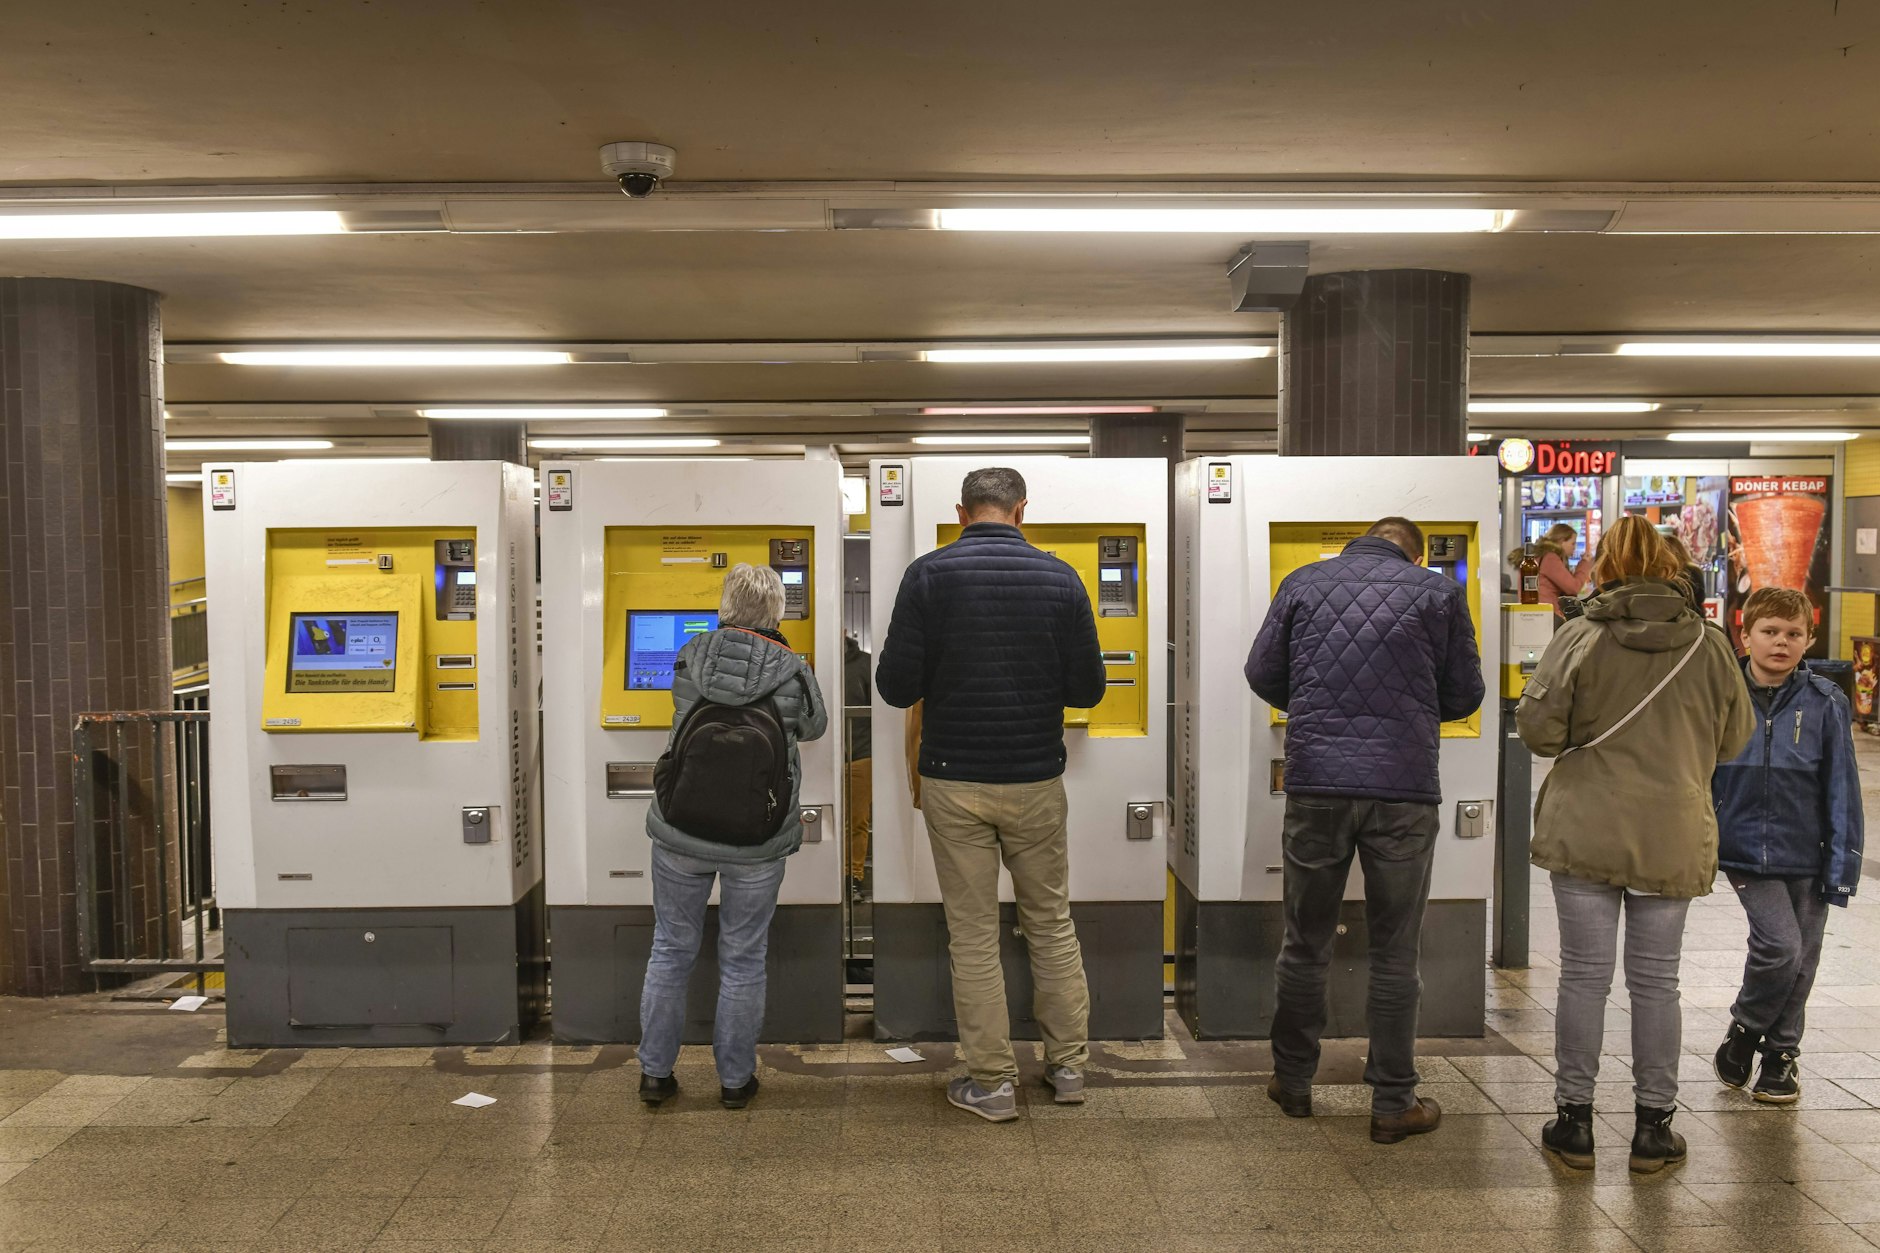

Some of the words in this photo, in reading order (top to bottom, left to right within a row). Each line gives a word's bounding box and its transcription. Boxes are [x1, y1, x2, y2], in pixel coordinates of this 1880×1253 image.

[1537, 442, 1616, 474] Döner
[1735, 480, 1779, 492] DÖNER
[1782, 481, 1824, 491] KEBAP
[368, 678, 389, 686] Handy
[512, 709, 522, 868] Fahrscheine
[521, 771, 529, 864] Tickets
